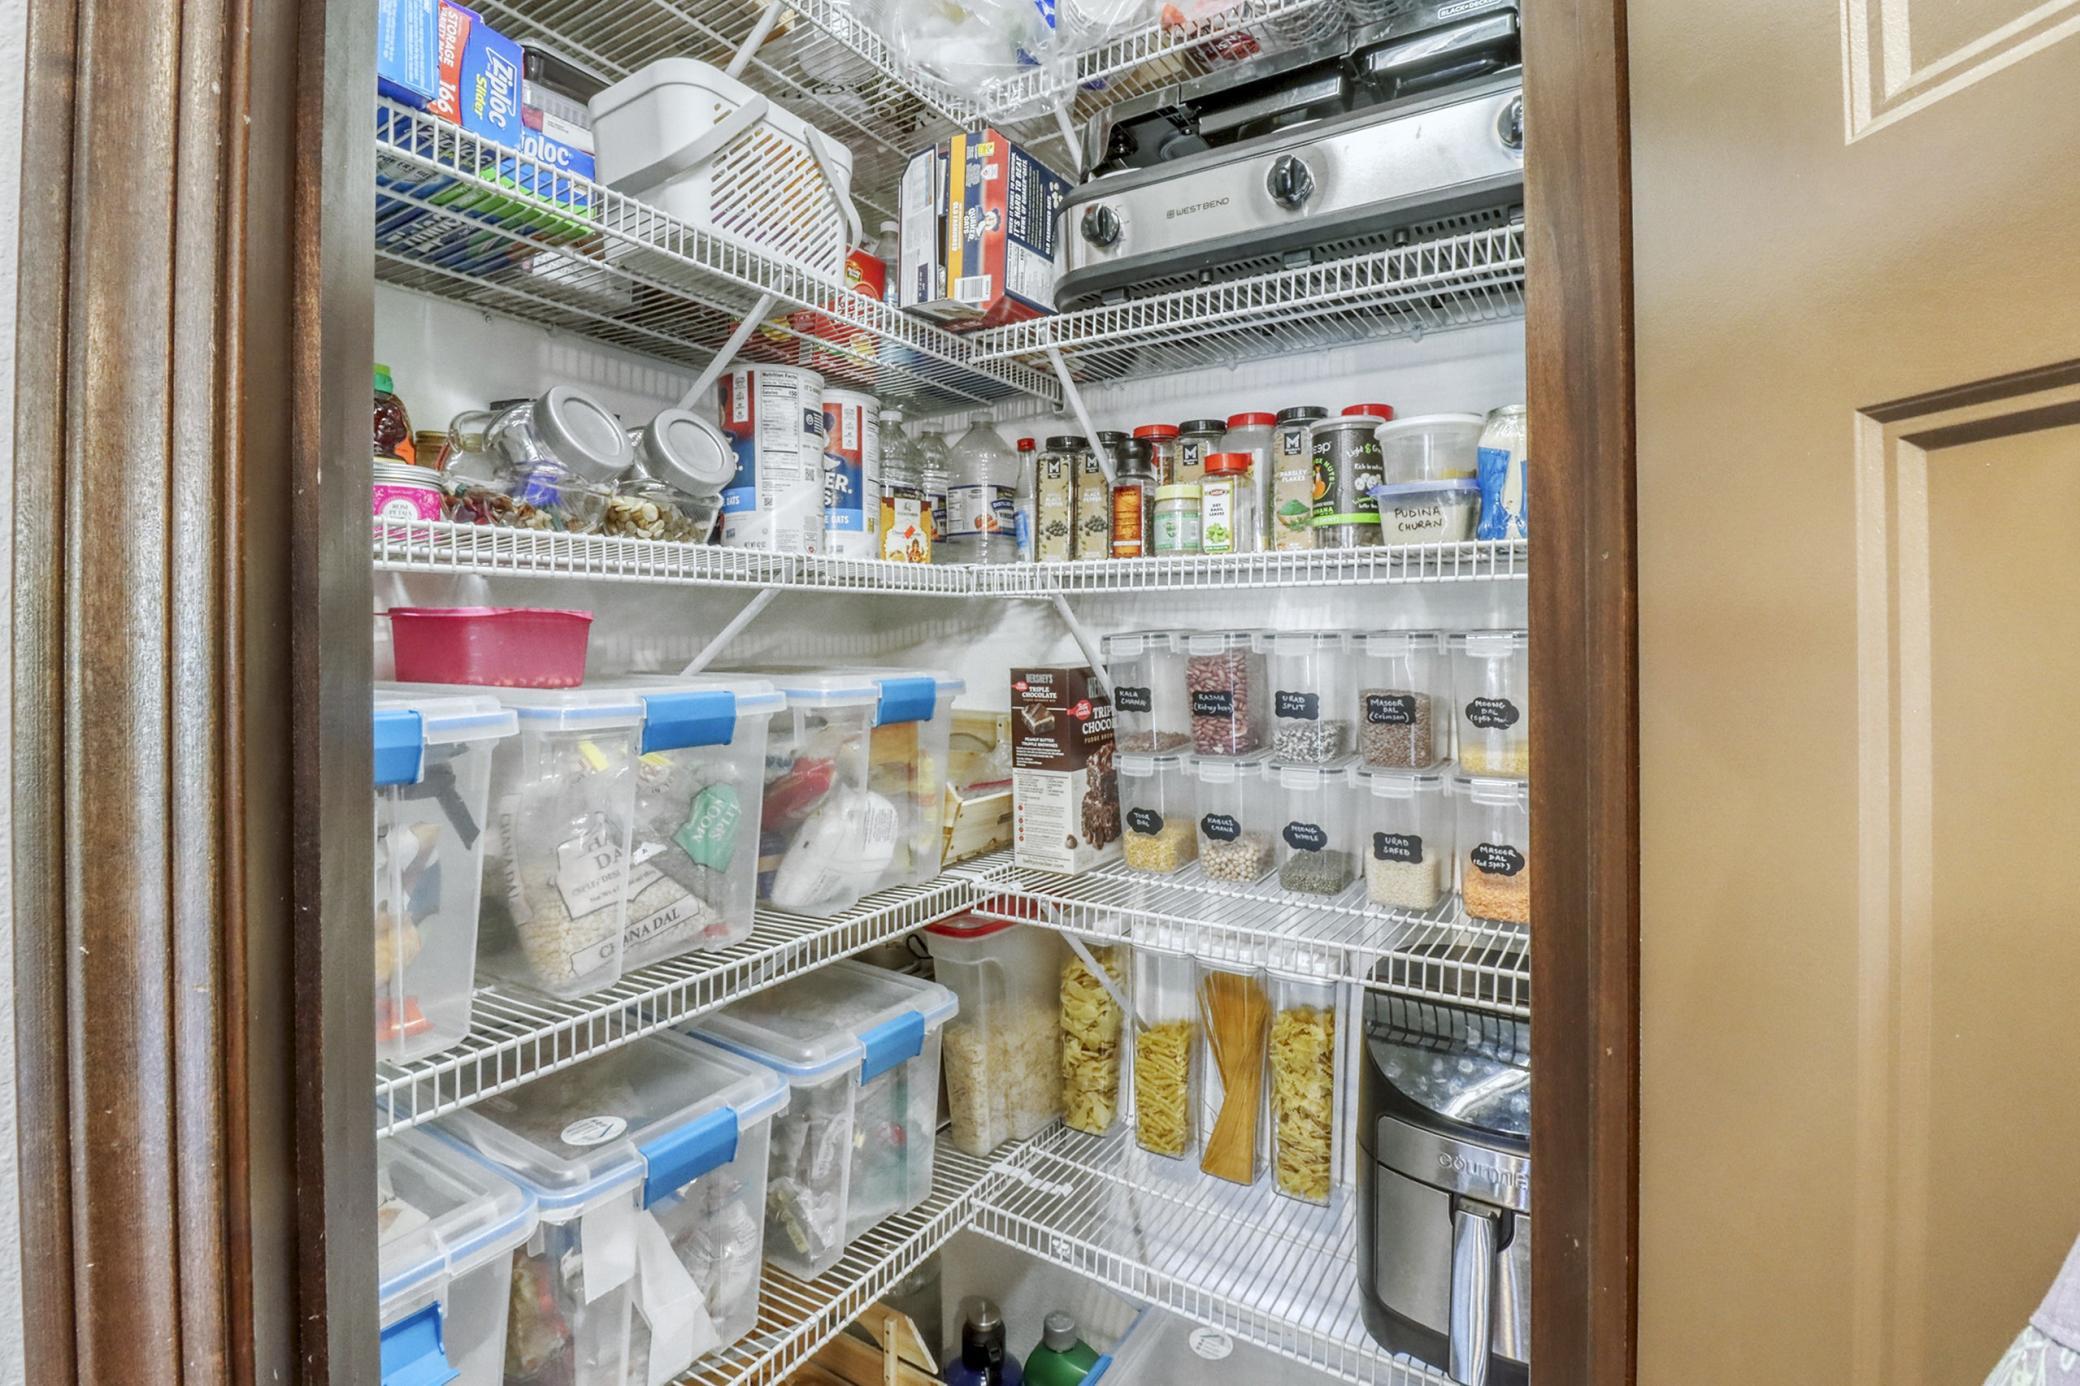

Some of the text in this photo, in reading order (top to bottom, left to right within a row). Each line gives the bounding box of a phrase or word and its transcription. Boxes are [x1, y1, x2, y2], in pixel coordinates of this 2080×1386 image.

[443, 9, 459, 68] STORAGE
[437, 79, 457, 115] 166
[473, 72, 488, 121] Slider
[487, 55, 515, 129] Ziploc
[1014, 180, 1022, 192] TO
[1014, 194, 1022, 220] HARD
[1394, 506, 1442, 519] PUDINA
[1398, 518, 1443, 532] CHURAN
[1281, 702, 1306, 711] SPLIT
[1370, 699, 1404, 707] MASOOR
[1082, 718, 1112, 735] CHOCO
[1384, 836, 1409, 847] URAD
[1479, 846, 1517, 858] MASOOR
[1488, 854, 1508, 862] DAL
[652, 908, 681, 931] DAL
